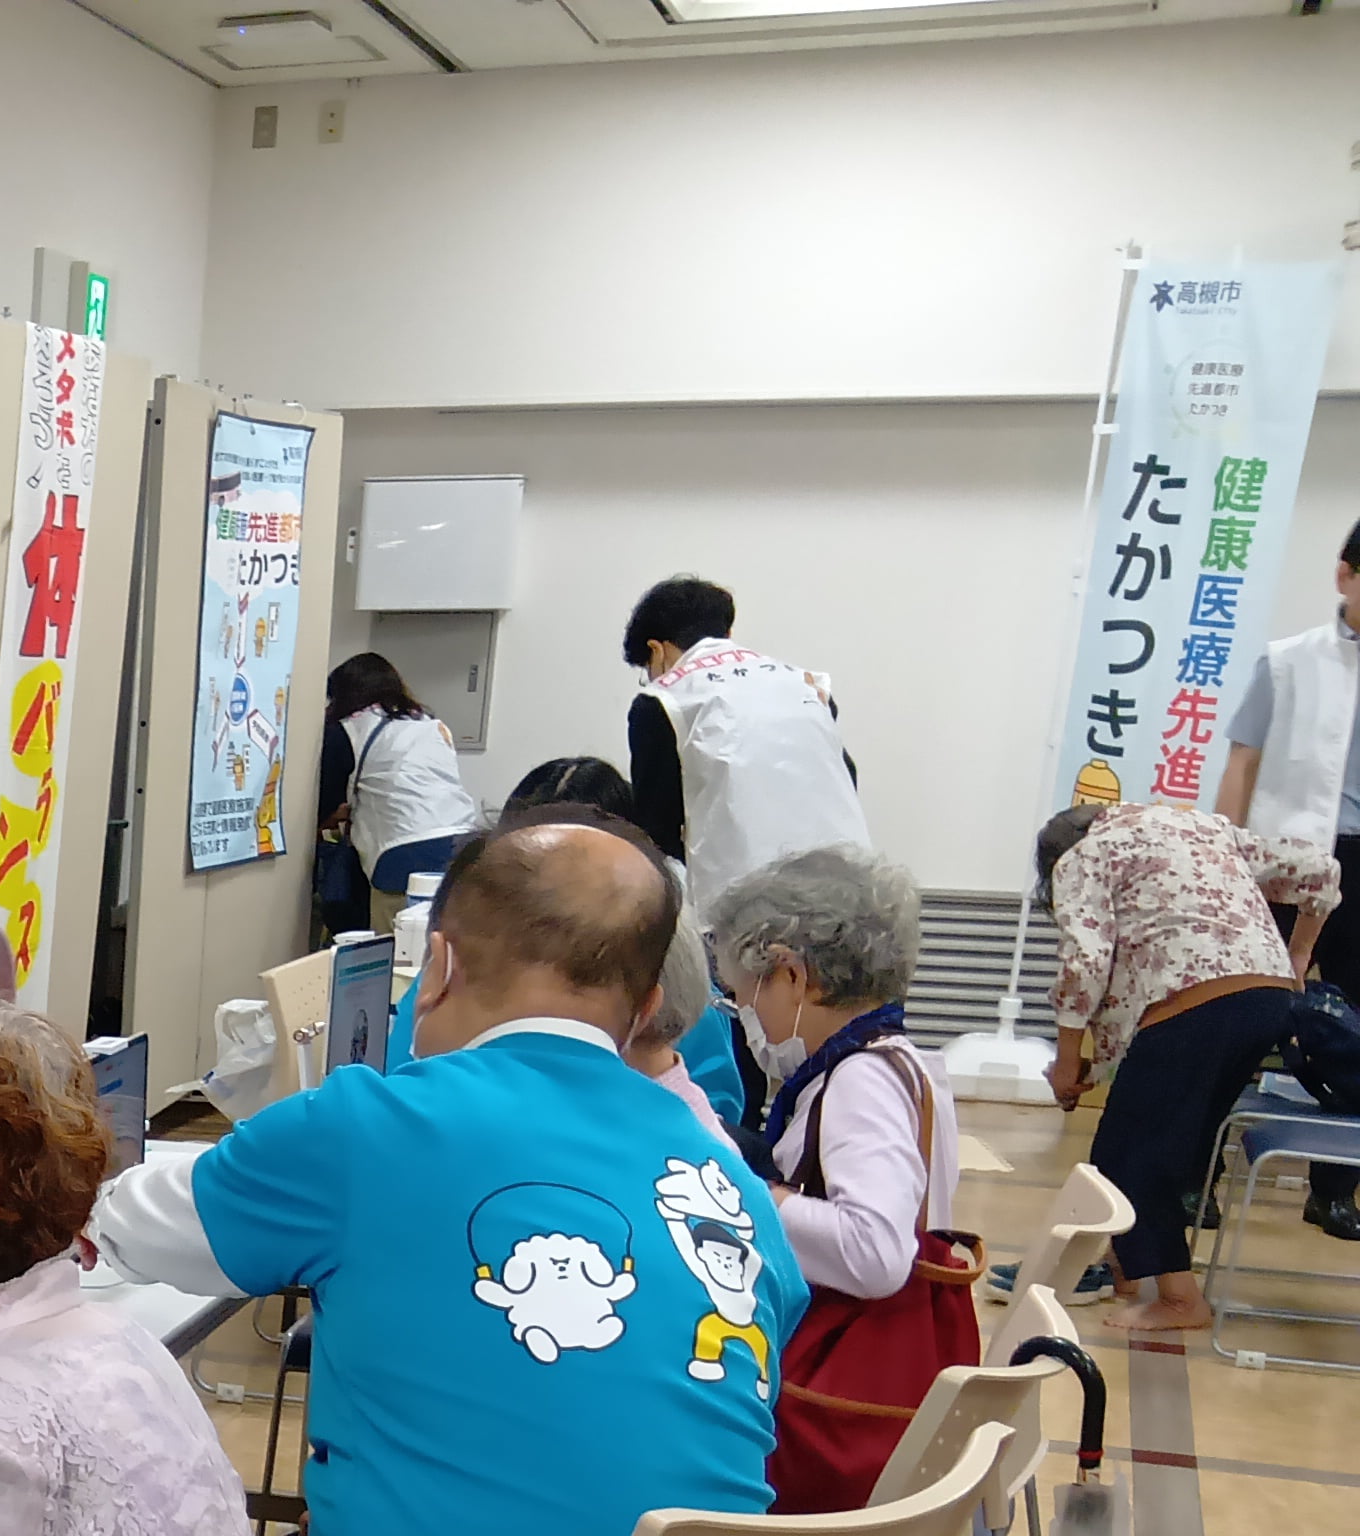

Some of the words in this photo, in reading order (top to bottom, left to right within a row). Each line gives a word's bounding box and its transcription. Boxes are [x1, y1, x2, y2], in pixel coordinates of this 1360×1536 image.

[1177, 281, 1242, 304] 高槻市
[1087, 453, 1188, 757] たかつき
[1150, 456, 1268, 811] 健康医療先進
